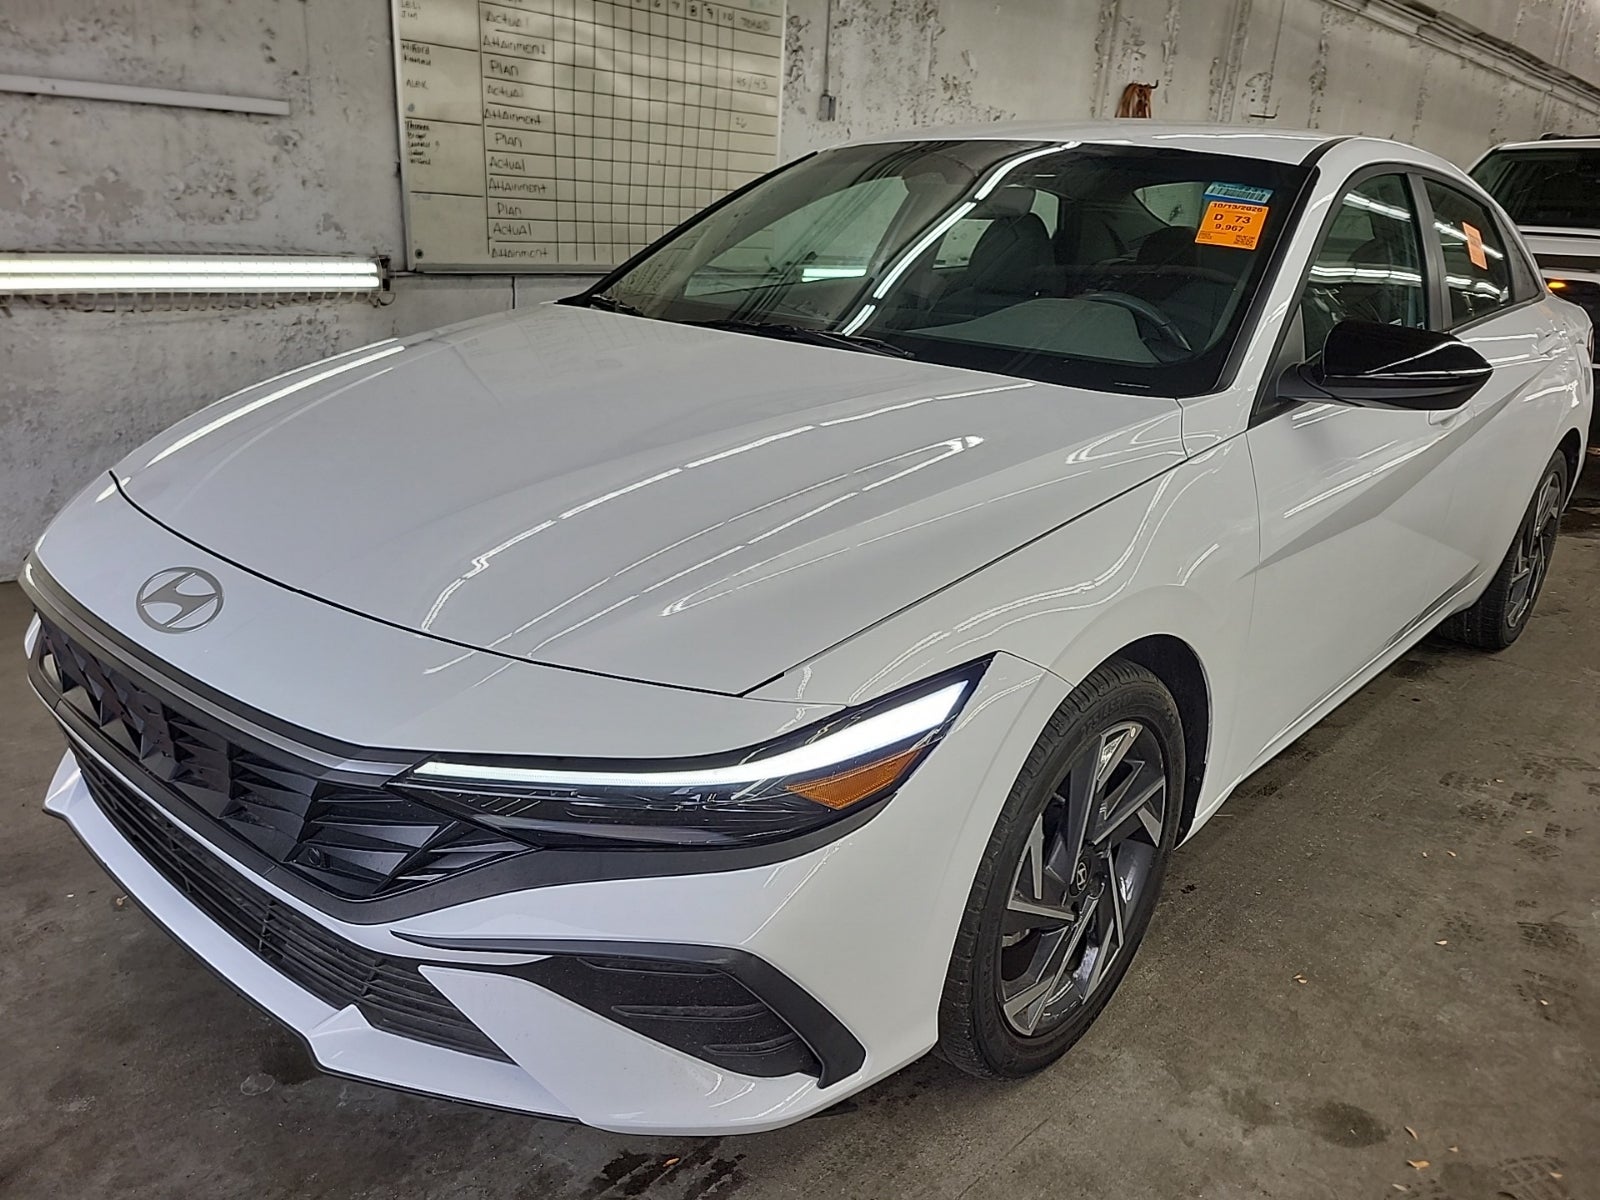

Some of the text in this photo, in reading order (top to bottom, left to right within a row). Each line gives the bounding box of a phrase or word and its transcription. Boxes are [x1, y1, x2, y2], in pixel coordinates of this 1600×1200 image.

[495, 132, 523, 148] Plan
[1213, 213, 1252, 224] D 73
